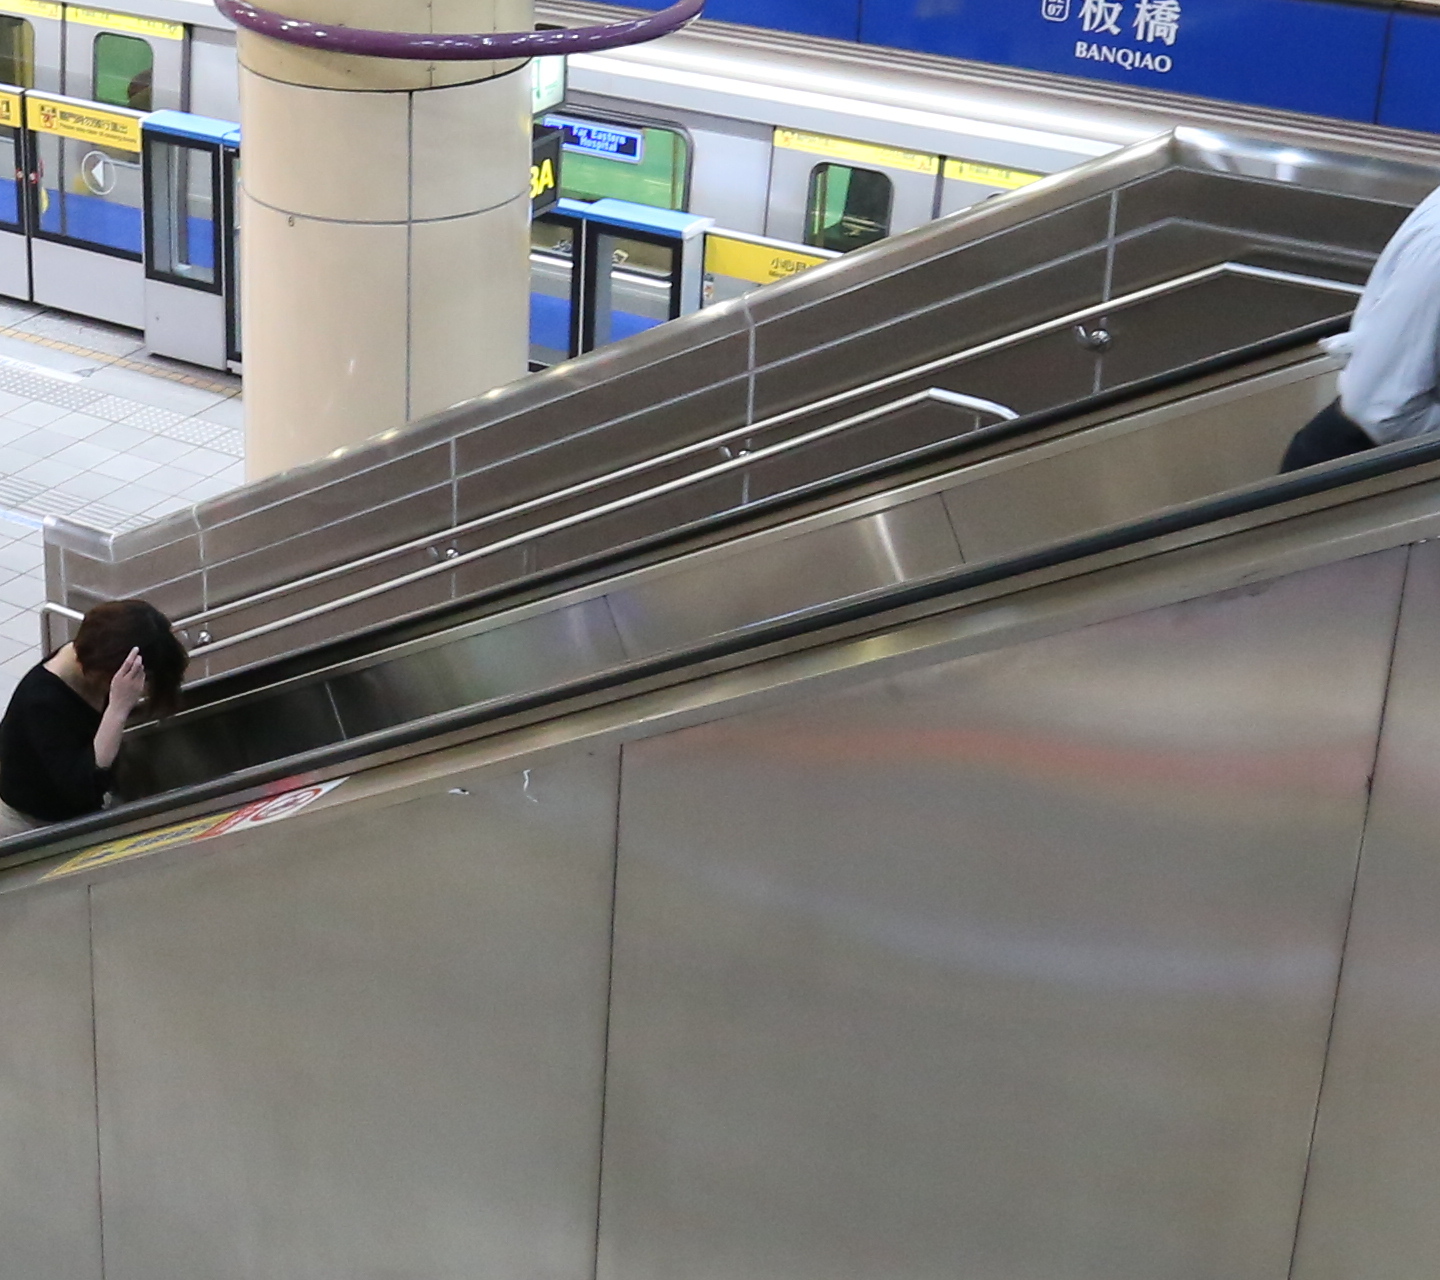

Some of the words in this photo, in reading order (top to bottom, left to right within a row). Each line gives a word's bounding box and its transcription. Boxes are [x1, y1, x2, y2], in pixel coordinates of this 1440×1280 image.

[1047, 4, 1065, 17] 07
[1074, 40, 1173, 73] BANQIAO
[572, 125, 589, 138] Far
[590, 129, 627, 145] Eastern
[579, 136, 618, 152] Hospital
